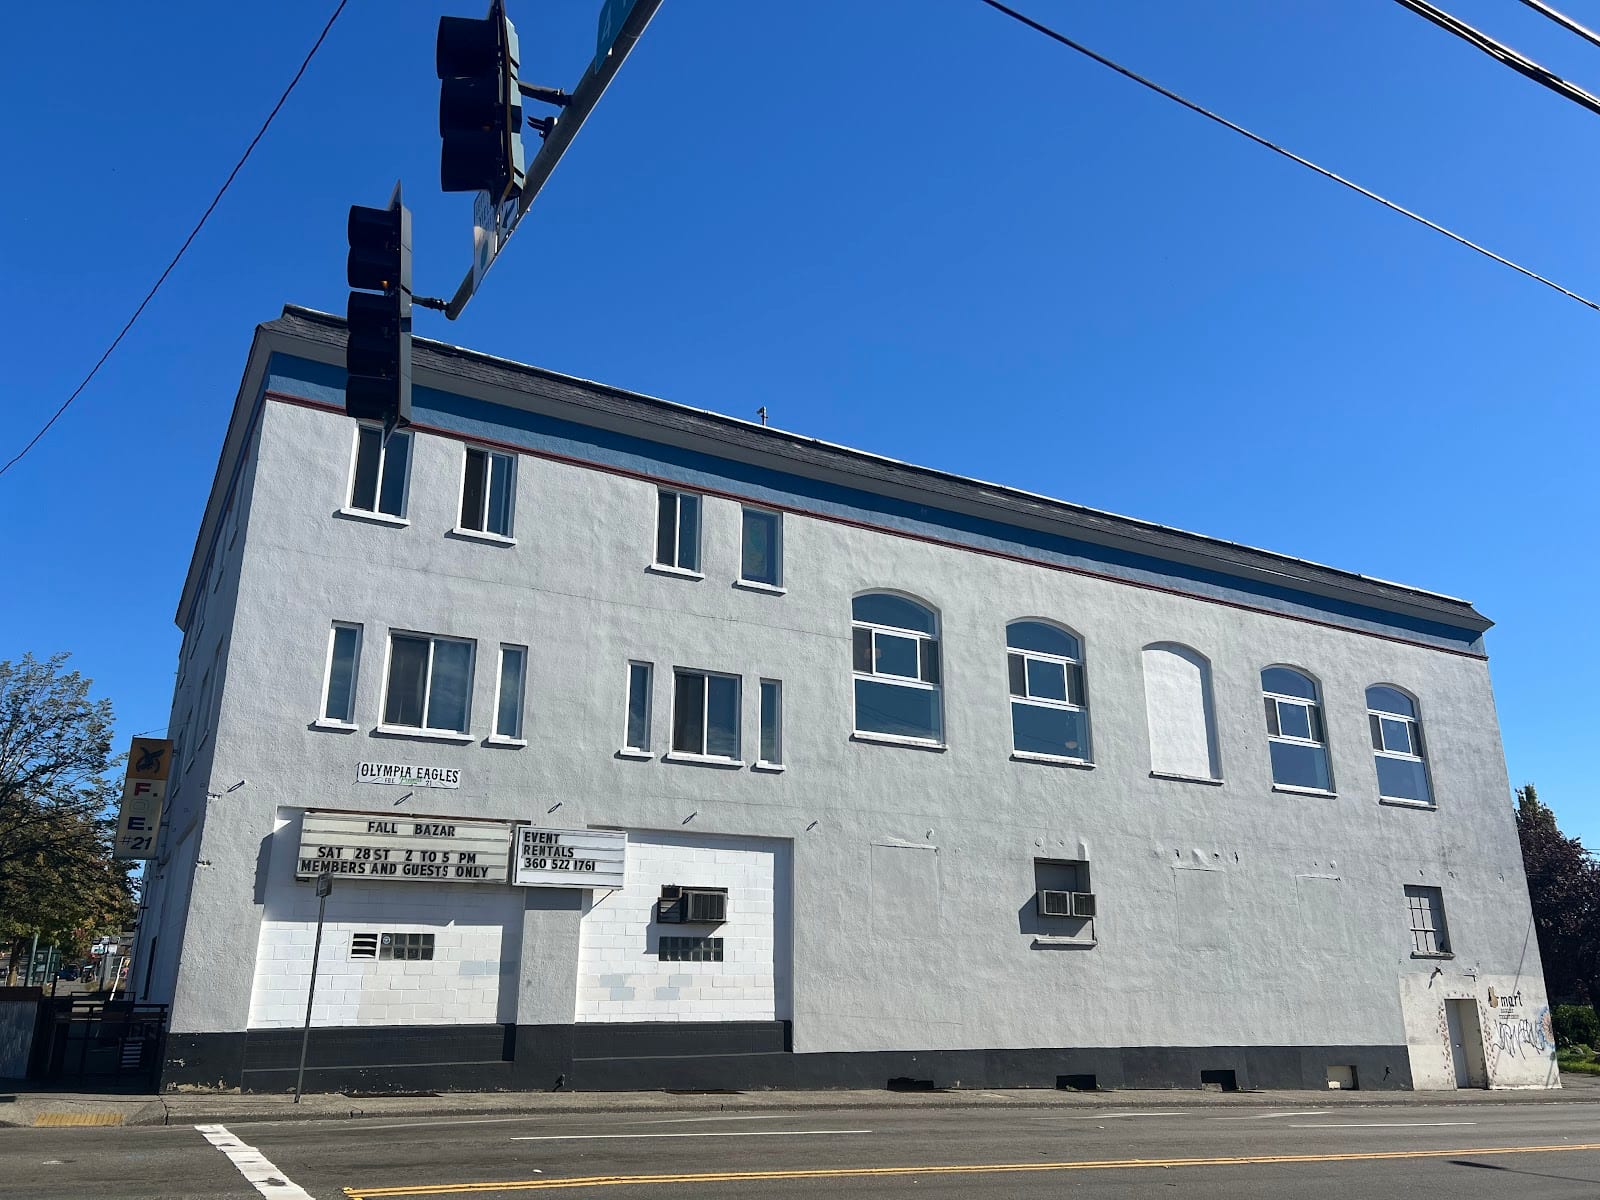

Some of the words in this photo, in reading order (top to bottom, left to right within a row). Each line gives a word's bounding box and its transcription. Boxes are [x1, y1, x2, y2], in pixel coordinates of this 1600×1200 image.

[361, 763, 411, 778] OLYMPIA
[417, 767, 459, 783] EAGLES
[367, 821, 398, 834] FALL
[415, 824, 456, 837] BAZAR
[119, 836, 153, 851] #21
[525, 832, 560, 844] EVENT
[318, 847, 343, 858] SAT
[405, 849, 413, 862] 2
[421, 851, 436, 863] TO
[442, 852, 450, 863] 5
[459, 853, 476, 864] PM
[523, 845, 574, 858] RENTALS
[301, 860, 366, 874] MEMBERS
[371, 863, 397, 875] AND
[403, 864, 449, 877] GUESTS
[456, 866, 489, 878] ONLY
[525, 858, 546, 869] 360
[551, 860, 570, 870] 522
[574, 860, 595, 871] 1761
